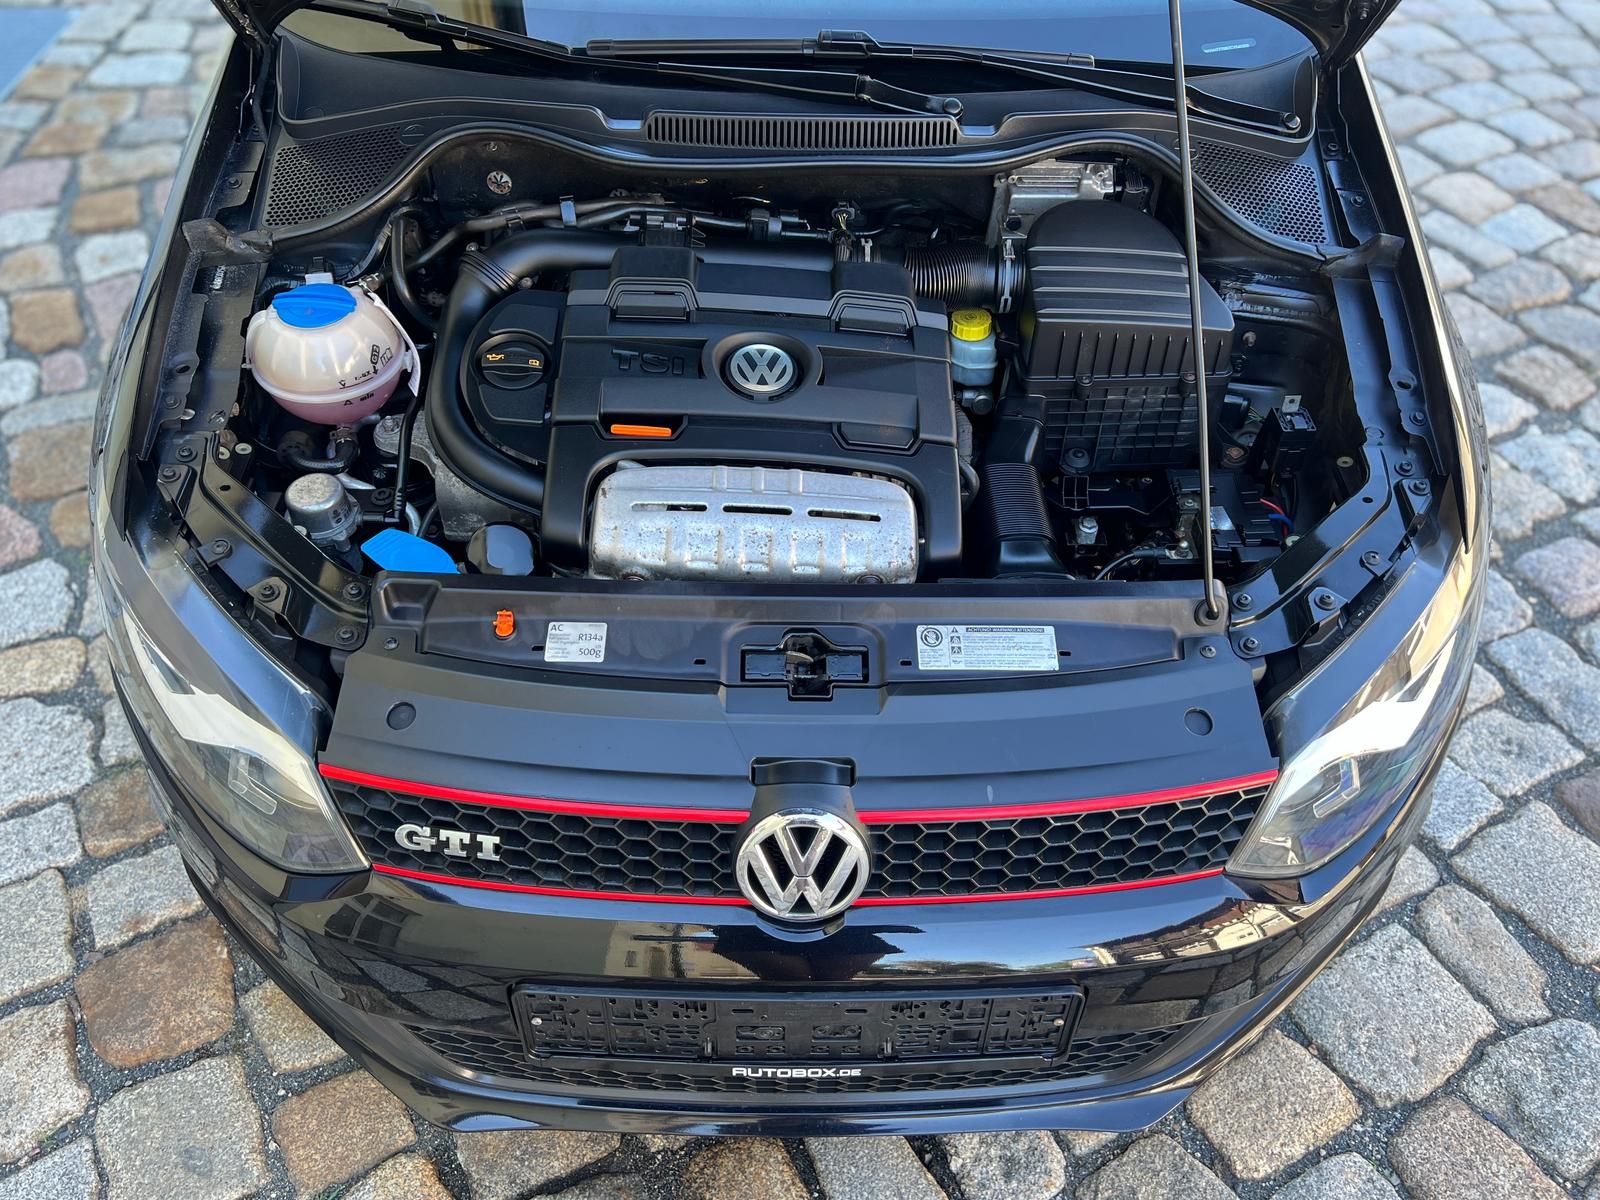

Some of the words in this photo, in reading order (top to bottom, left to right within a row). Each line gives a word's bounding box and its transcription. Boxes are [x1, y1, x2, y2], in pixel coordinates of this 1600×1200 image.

[610, 348, 685, 376] TSI
[550, 624, 564, 632] AC
[578, 633, 603, 642] R134a
[578, 648, 601, 658] 500g
[394, 823, 501, 862] GTI
[740, 813, 864, 919] VW
[732, 1067, 862, 1078] AUTOBOX.DE
